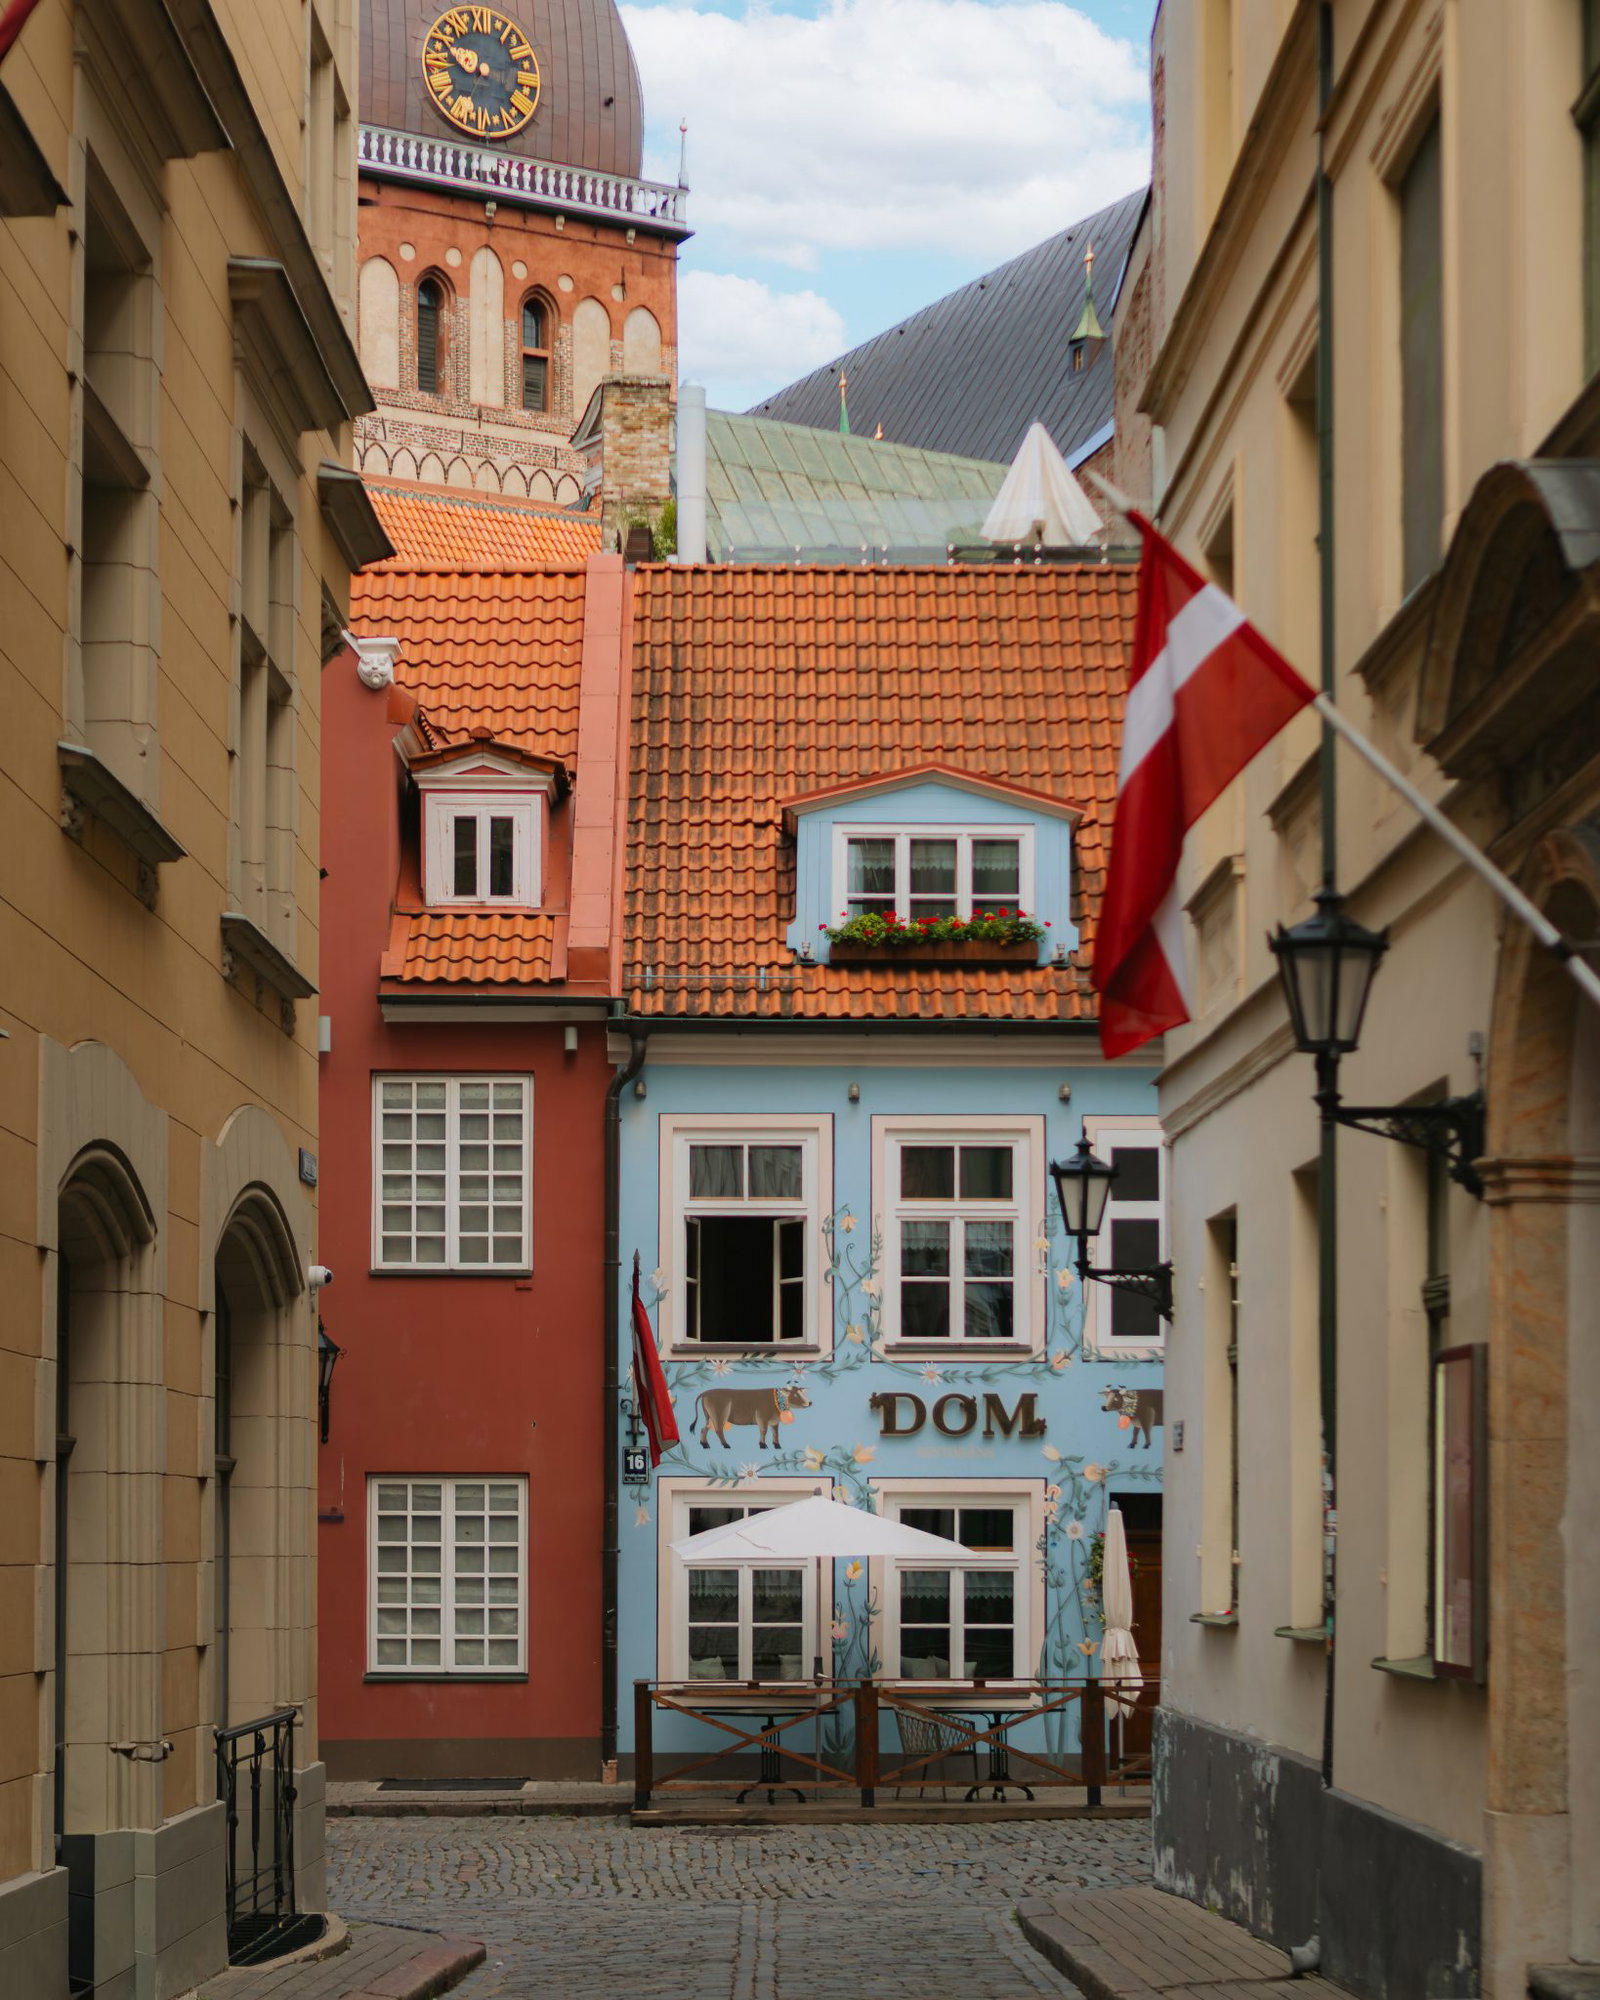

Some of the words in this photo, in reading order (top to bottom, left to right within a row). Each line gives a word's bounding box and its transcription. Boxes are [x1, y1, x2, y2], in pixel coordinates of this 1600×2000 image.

[472, 8, 491, 34] XII
[509, 44, 532, 61] II
[517, 71, 539, 88] III
[477, 106, 491, 131] VI
[500, 106, 516, 129] V
[870, 1392, 1047, 1437] DOM
[626, 1454, 645, 1470] 16
